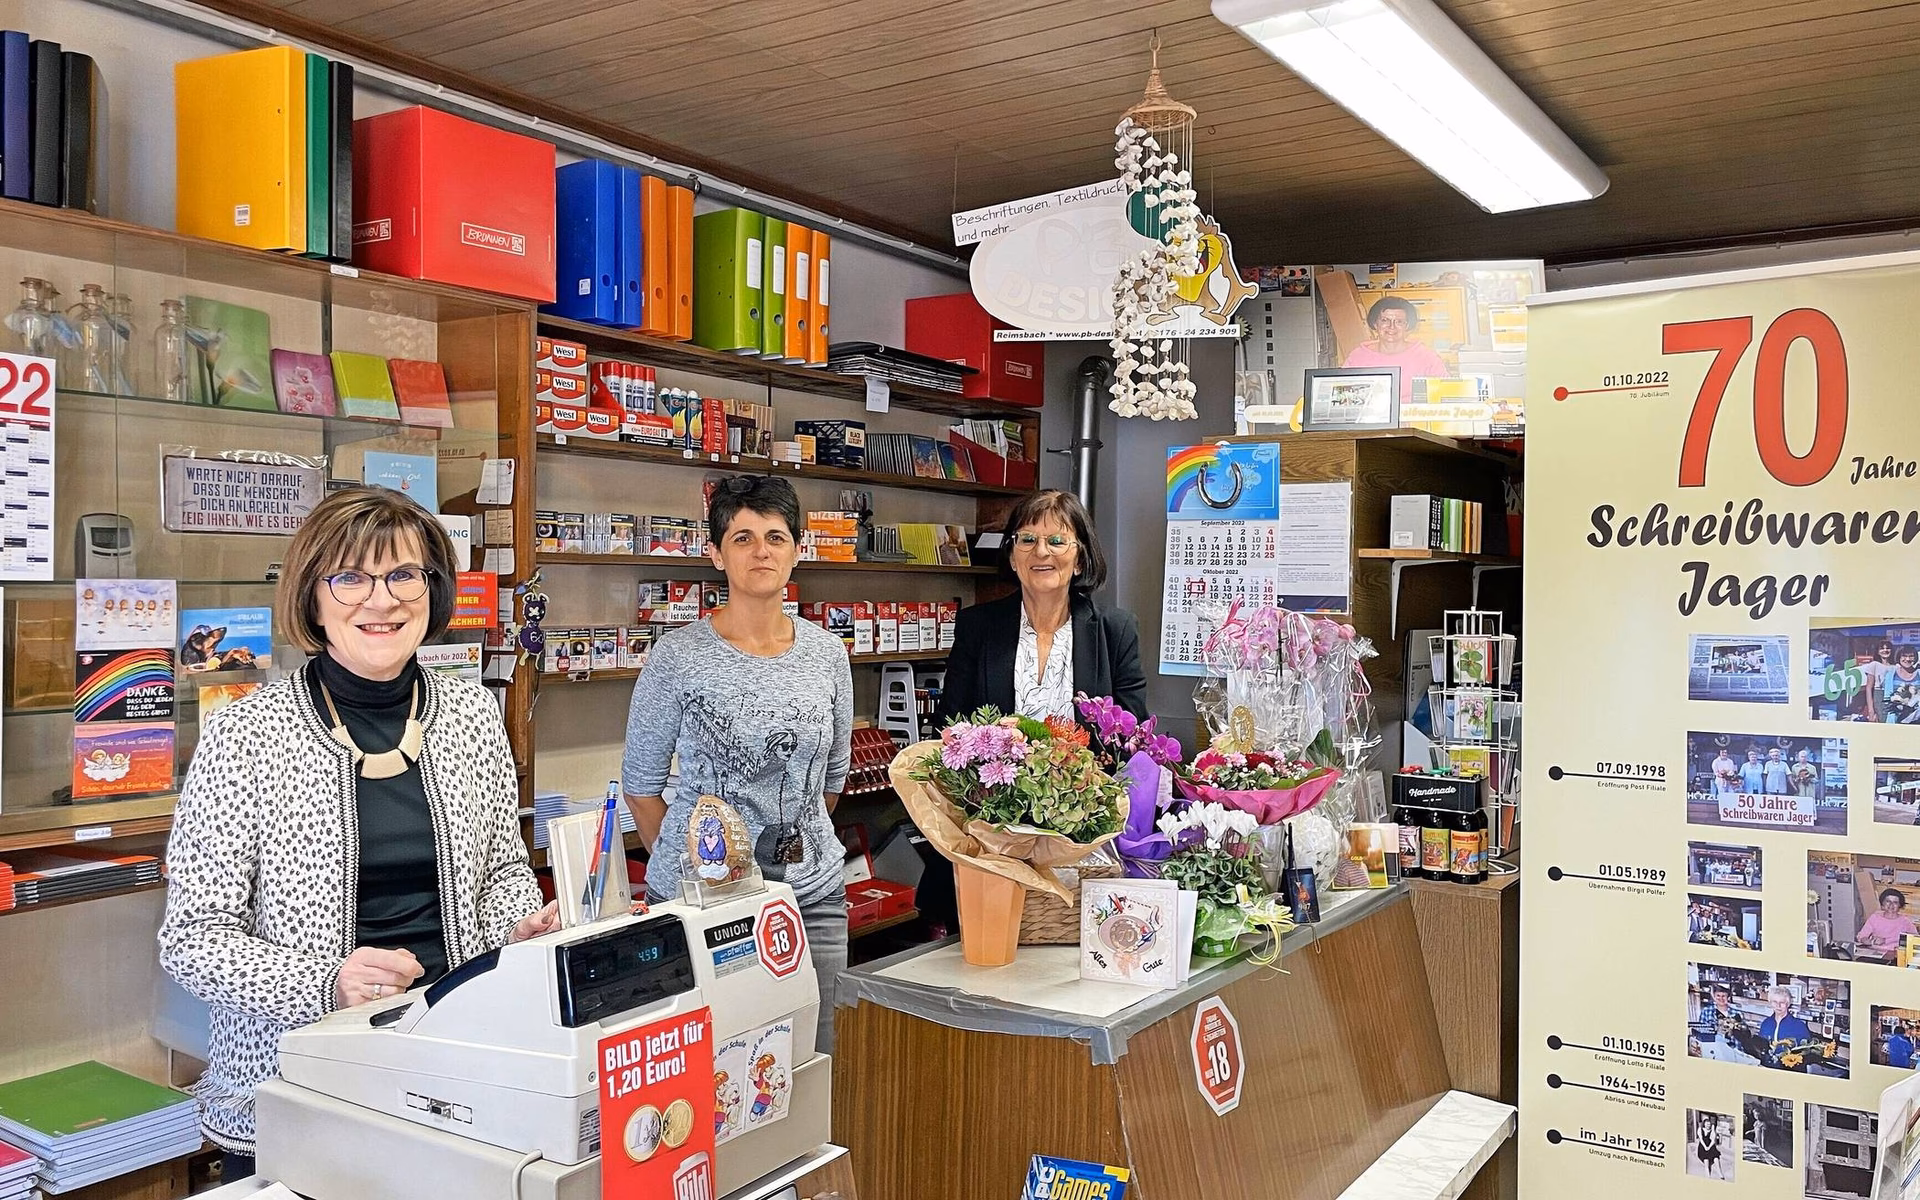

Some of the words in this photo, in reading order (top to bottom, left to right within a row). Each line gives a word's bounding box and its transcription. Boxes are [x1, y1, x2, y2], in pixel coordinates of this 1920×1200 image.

[958, 230, 977, 242] und
[996, 331, 1046, 339] Reimsbach
[1199, 328, 1216, 336] 234
[555, 346, 574, 356] West
[554, 378, 574, 388] West
[1604, 371, 1668, 386] 01.10.2022
[1662, 307, 1849, 488] 70
[555, 410, 574, 419] West
[589, 414, 608, 423] West
[186, 467, 222, 482] WARTE
[226, 470, 257, 484] NICHT
[1850, 456, 1917, 485] Jahre
[194, 483, 220, 497] DASS
[224, 484, 240, 498] DIE
[244, 486, 300, 500] MENSCHEN
[201, 498, 224, 511] DICH
[182, 512, 203, 526] ZEIG
[207, 513, 242, 528] IHNEN,
[245, 514, 263, 528] WIE
[267, 515, 279, 528] ES
[1678, 561, 1830, 620] Jager
[1824, 658, 1862, 700] 65
[126, 686, 168, 697] DANKE.
[1596, 762, 1665, 777] 07.09.1998
[1408, 786, 1456, 797] Handmade
[1597, 781, 1628, 790] Eröffnung
[1738, 794, 1754, 808] 50
[1759, 796, 1797, 811] Jahre
[1723, 808, 1783, 822] Schreibwaren
[1787, 812, 1813, 825] Jager
[1599, 864, 1666, 881] 01.05.1989
[1627, 886, 1645, 894] Birgit
[714, 922, 749, 941] UNION
[772, 930, 790, 954] 18
[1089, 950, 1107, 969] Alles
[1142, 959, 1164, 973] Gute
[774, 1024, 790, 1033] Schule
[605, 1039, 641, 1072] BILD
[646, 1027, 680, 1061] jetzt
[683, 1021, 704, 1046] für
[729, 1040, 746, 1048] Schule
[1602, 1036, 1665, 1056] 01.10.1965
[1208, 1041, 1231, 1085] 18
[1594, 1054, 1625, 1065] Eröffnung
[1646, 1062, 1665, 1071] Filiale
[607, 1066, 641, 1099] 1,20
[646, 1051, 686, 1086] Euro!
[1600, 1074, 1665, 1096] 1964-1965
[1604, 1095, 1625, 1103] Abriss
[1627, 1098, 1639, 1106] und
[1641, 1100, 1665, 1111] Neubau
[1580, 1127, 1596, 1140] im
[1601, 1132, 1632, 1147] Jahr
[1636, 1138, 1665, 1154] 1962
[1589, 1148, 1611, 1158] Umzug
[1612, 1151, 1628, 1161] nach
[1630, 1155, 1665, 1168] Reimsbach
[1051, 1170, 1111, 1200] Games
